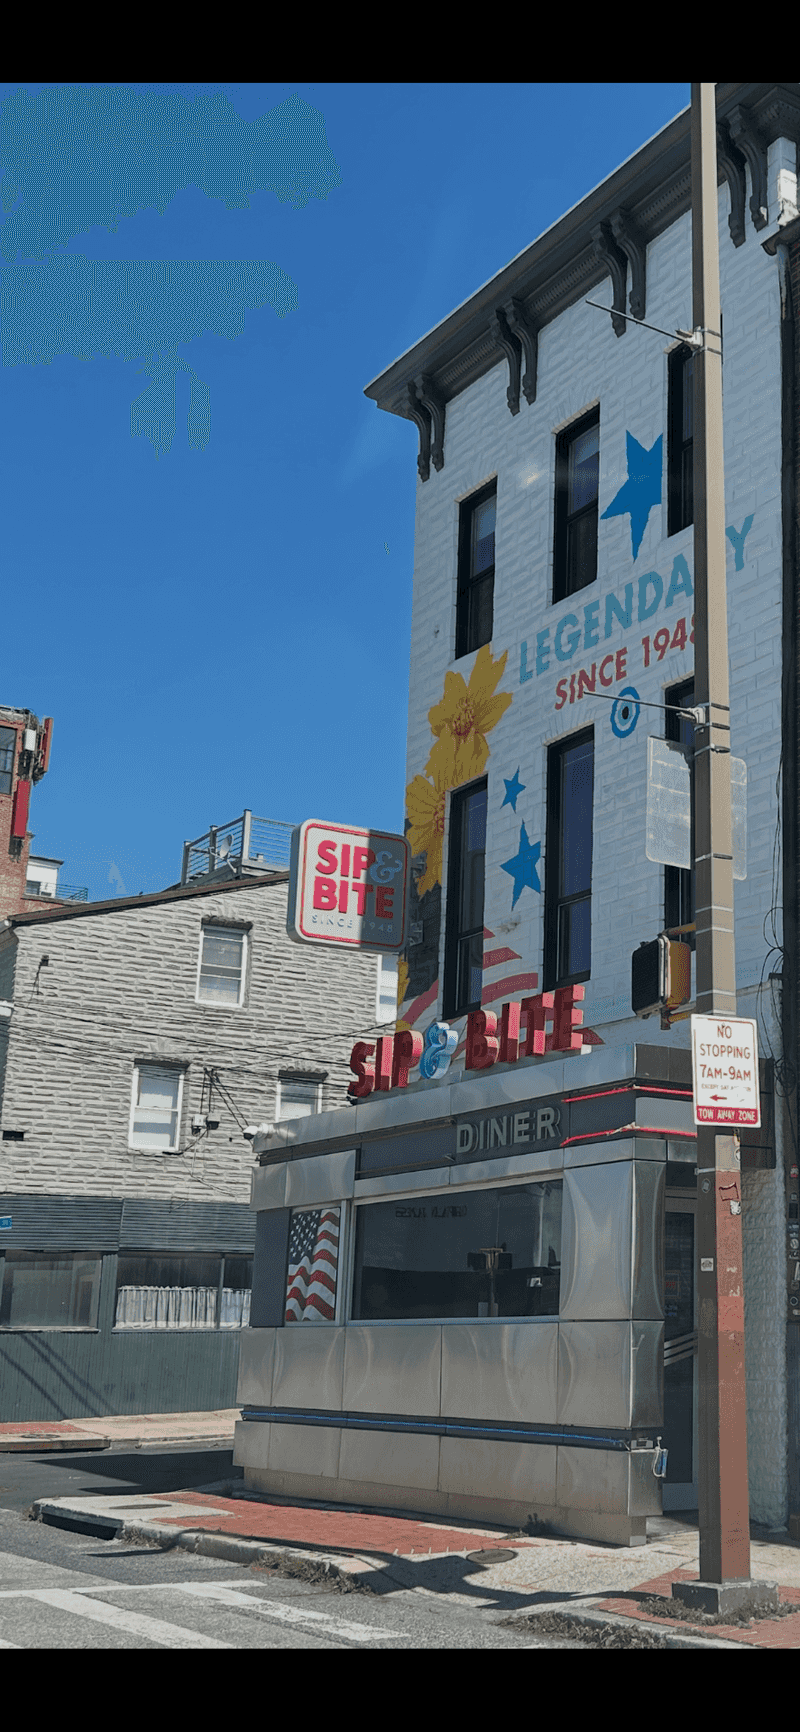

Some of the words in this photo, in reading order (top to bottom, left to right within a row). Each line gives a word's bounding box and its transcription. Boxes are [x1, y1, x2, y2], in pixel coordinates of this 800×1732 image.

[519, 513, 755, 684] LEGENDAY
[555, 647, 628, 710] SINCE
[313, 876, 395, 919] BITE
[311, 914, 353, 929] SINCE
[465, 984, 585, 1070] BITE
[716, 1025, 733, 1039] NO
[699, 1043, 751, 1060] STOPPING
[699, 1064, 752, 1081] 7AM-9AM
[698, 1108, 714, 1119] TOW
[716, 1109, 735, 1120] AWAY
[738, 1110, 756, 1121] ZONE
[456, 1106, 561, 1154] DINER
